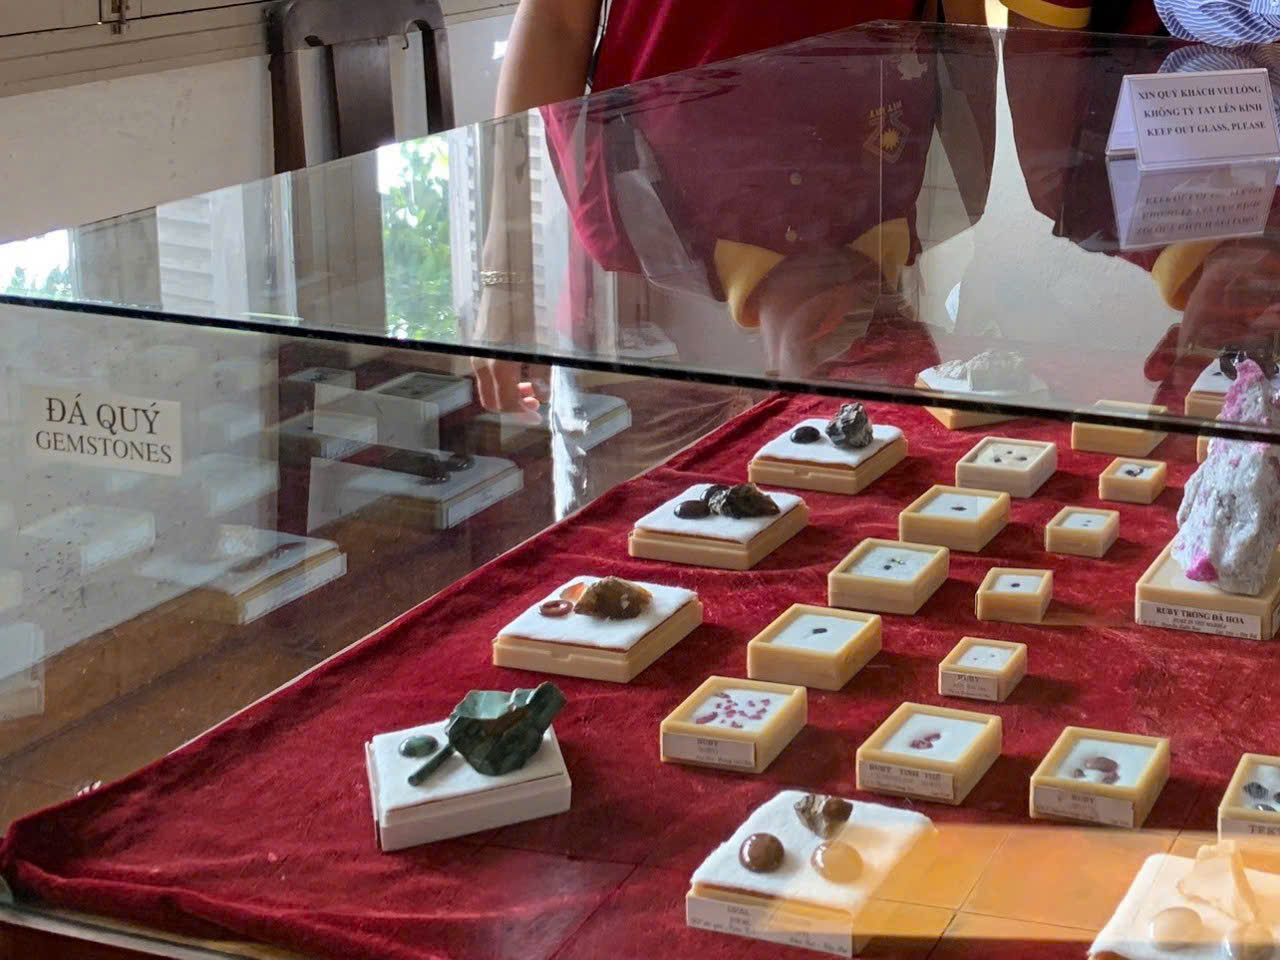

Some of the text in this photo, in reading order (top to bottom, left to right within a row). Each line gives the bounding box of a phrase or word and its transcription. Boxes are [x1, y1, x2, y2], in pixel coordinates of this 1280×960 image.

[1138, 91, 1155, 100] XIN
[1180, 85, 1215, 98] KHÁCH
[1216, 86, 1234, 96] VUI
[1198, 106, 1216, 115] TAY
[1147, 126, 1174, 137] KEEP
[1175, 125, 1195, 134] OUT
[1231, 120, 1267, 131] PLEASE
[45, 393, 160, 436] ĐÁ QUÝ
[35, 430, 173, 465] GEMSTONES
[1156, 606, 1179, 616] RUBY
